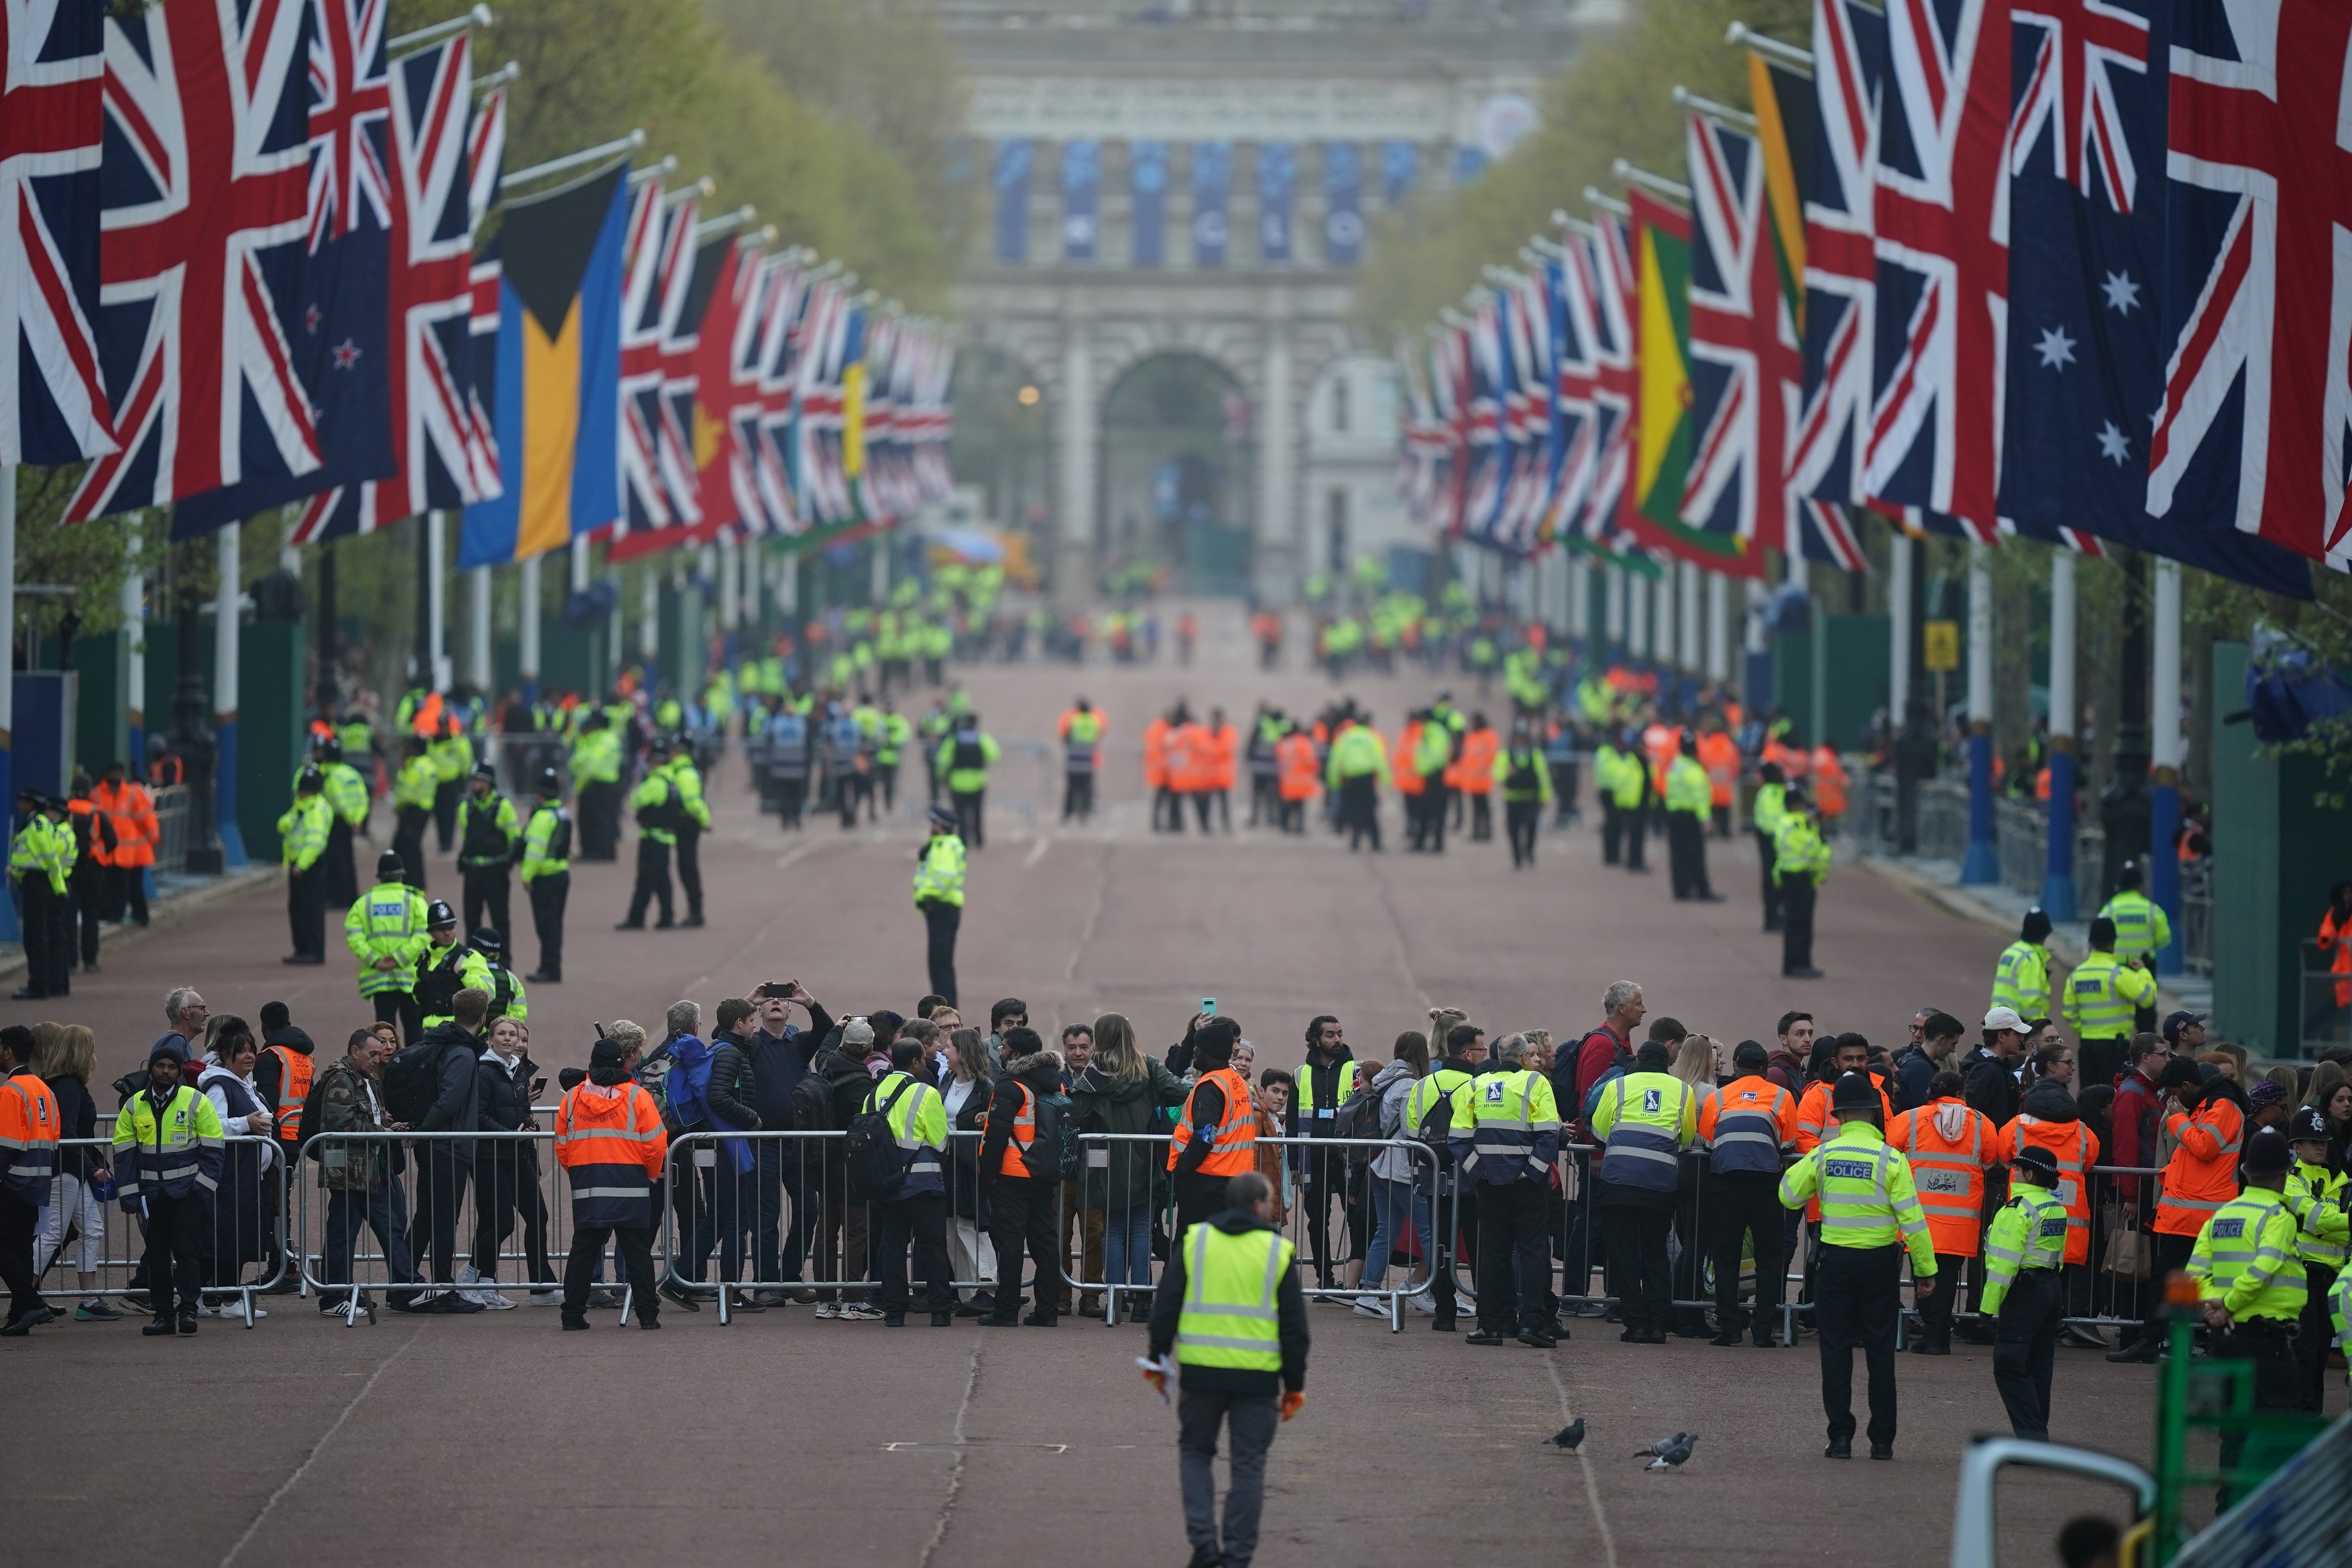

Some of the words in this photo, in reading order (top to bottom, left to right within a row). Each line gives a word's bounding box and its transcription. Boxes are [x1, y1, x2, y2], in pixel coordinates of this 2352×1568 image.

[1828, 1160, 1872, 1168] METROPOLITAN
[1827, 1166, 1871, 1178] POLICE
[2213, 1224, 2243, 1237] POLICE
